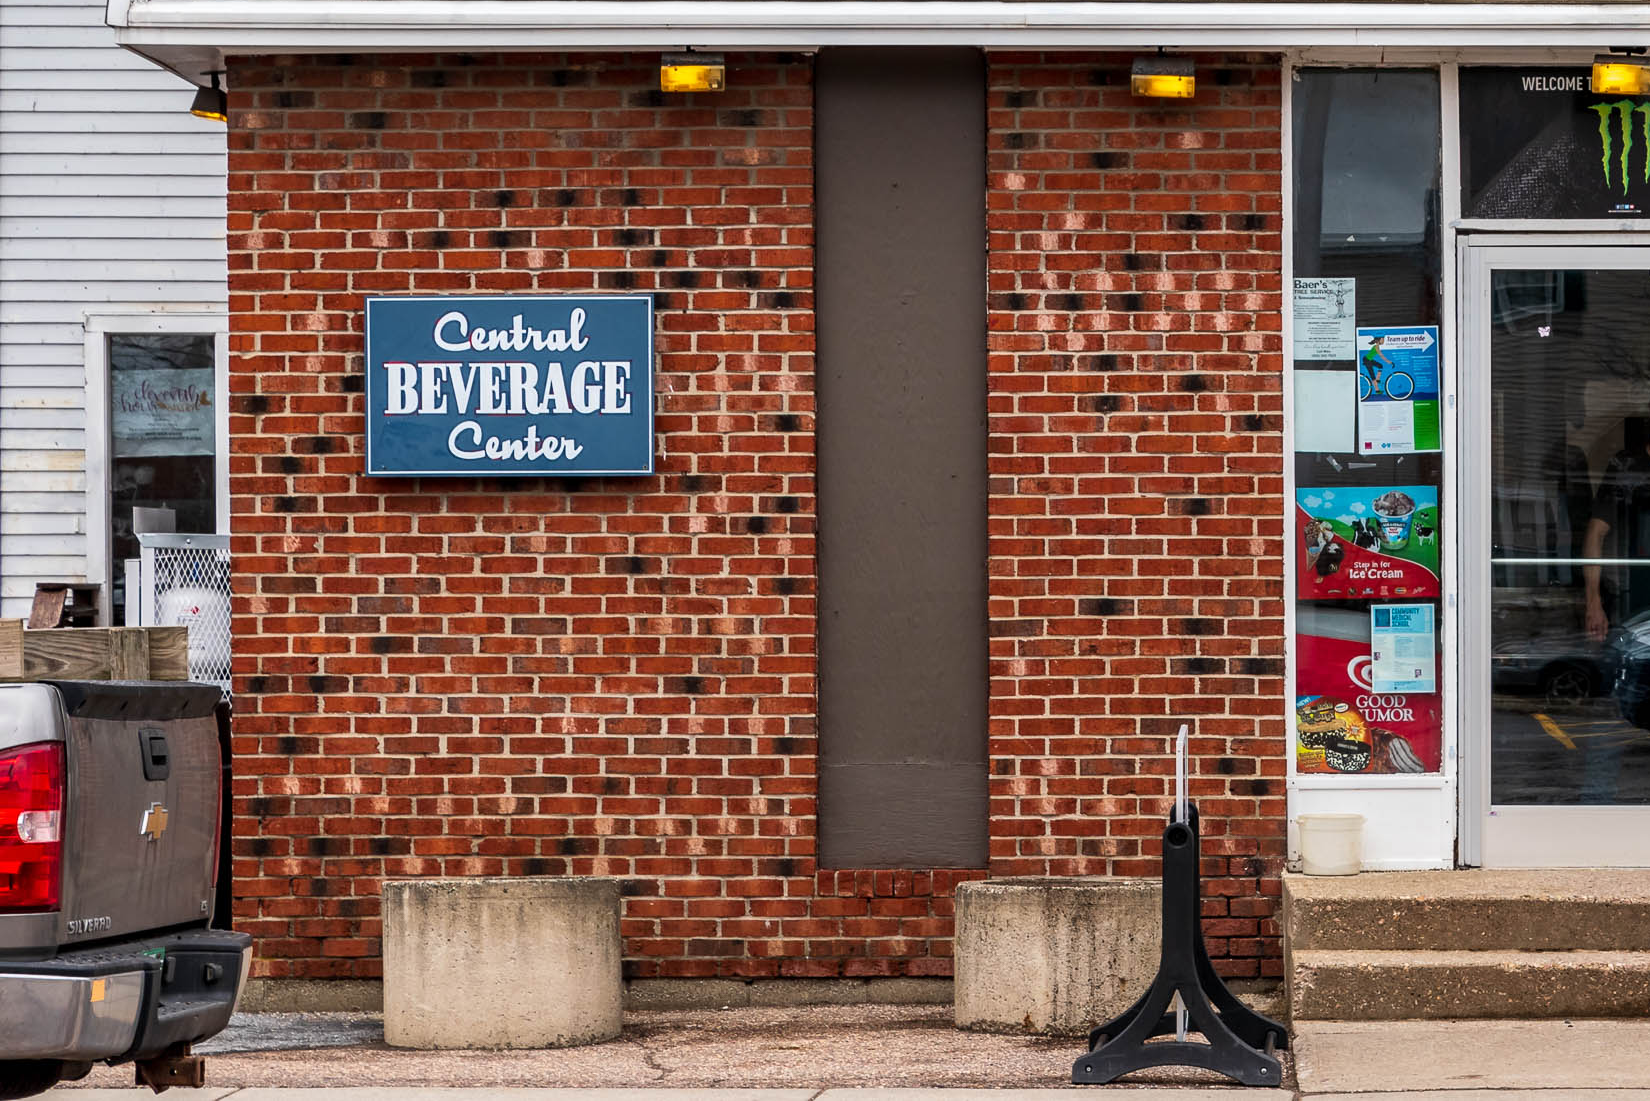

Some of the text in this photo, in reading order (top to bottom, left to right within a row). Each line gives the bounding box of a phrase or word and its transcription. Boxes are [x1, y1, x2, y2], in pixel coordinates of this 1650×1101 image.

[1522, 76, 1582, 91] WELCOME
[1294, 280, 1328, 289] Baer's
[434, 307, 590, 352] Central
[383, 361, 632, 415] BEVERAGE
[449, 420, 583, 460] Center
[1354, 561, 1370, 571] Step
[1349, 569, 1404, 579] Ice Cream
[1356, 694, 1406, 708] GOOD
[1359, 708, 1416, 722] UMOR
